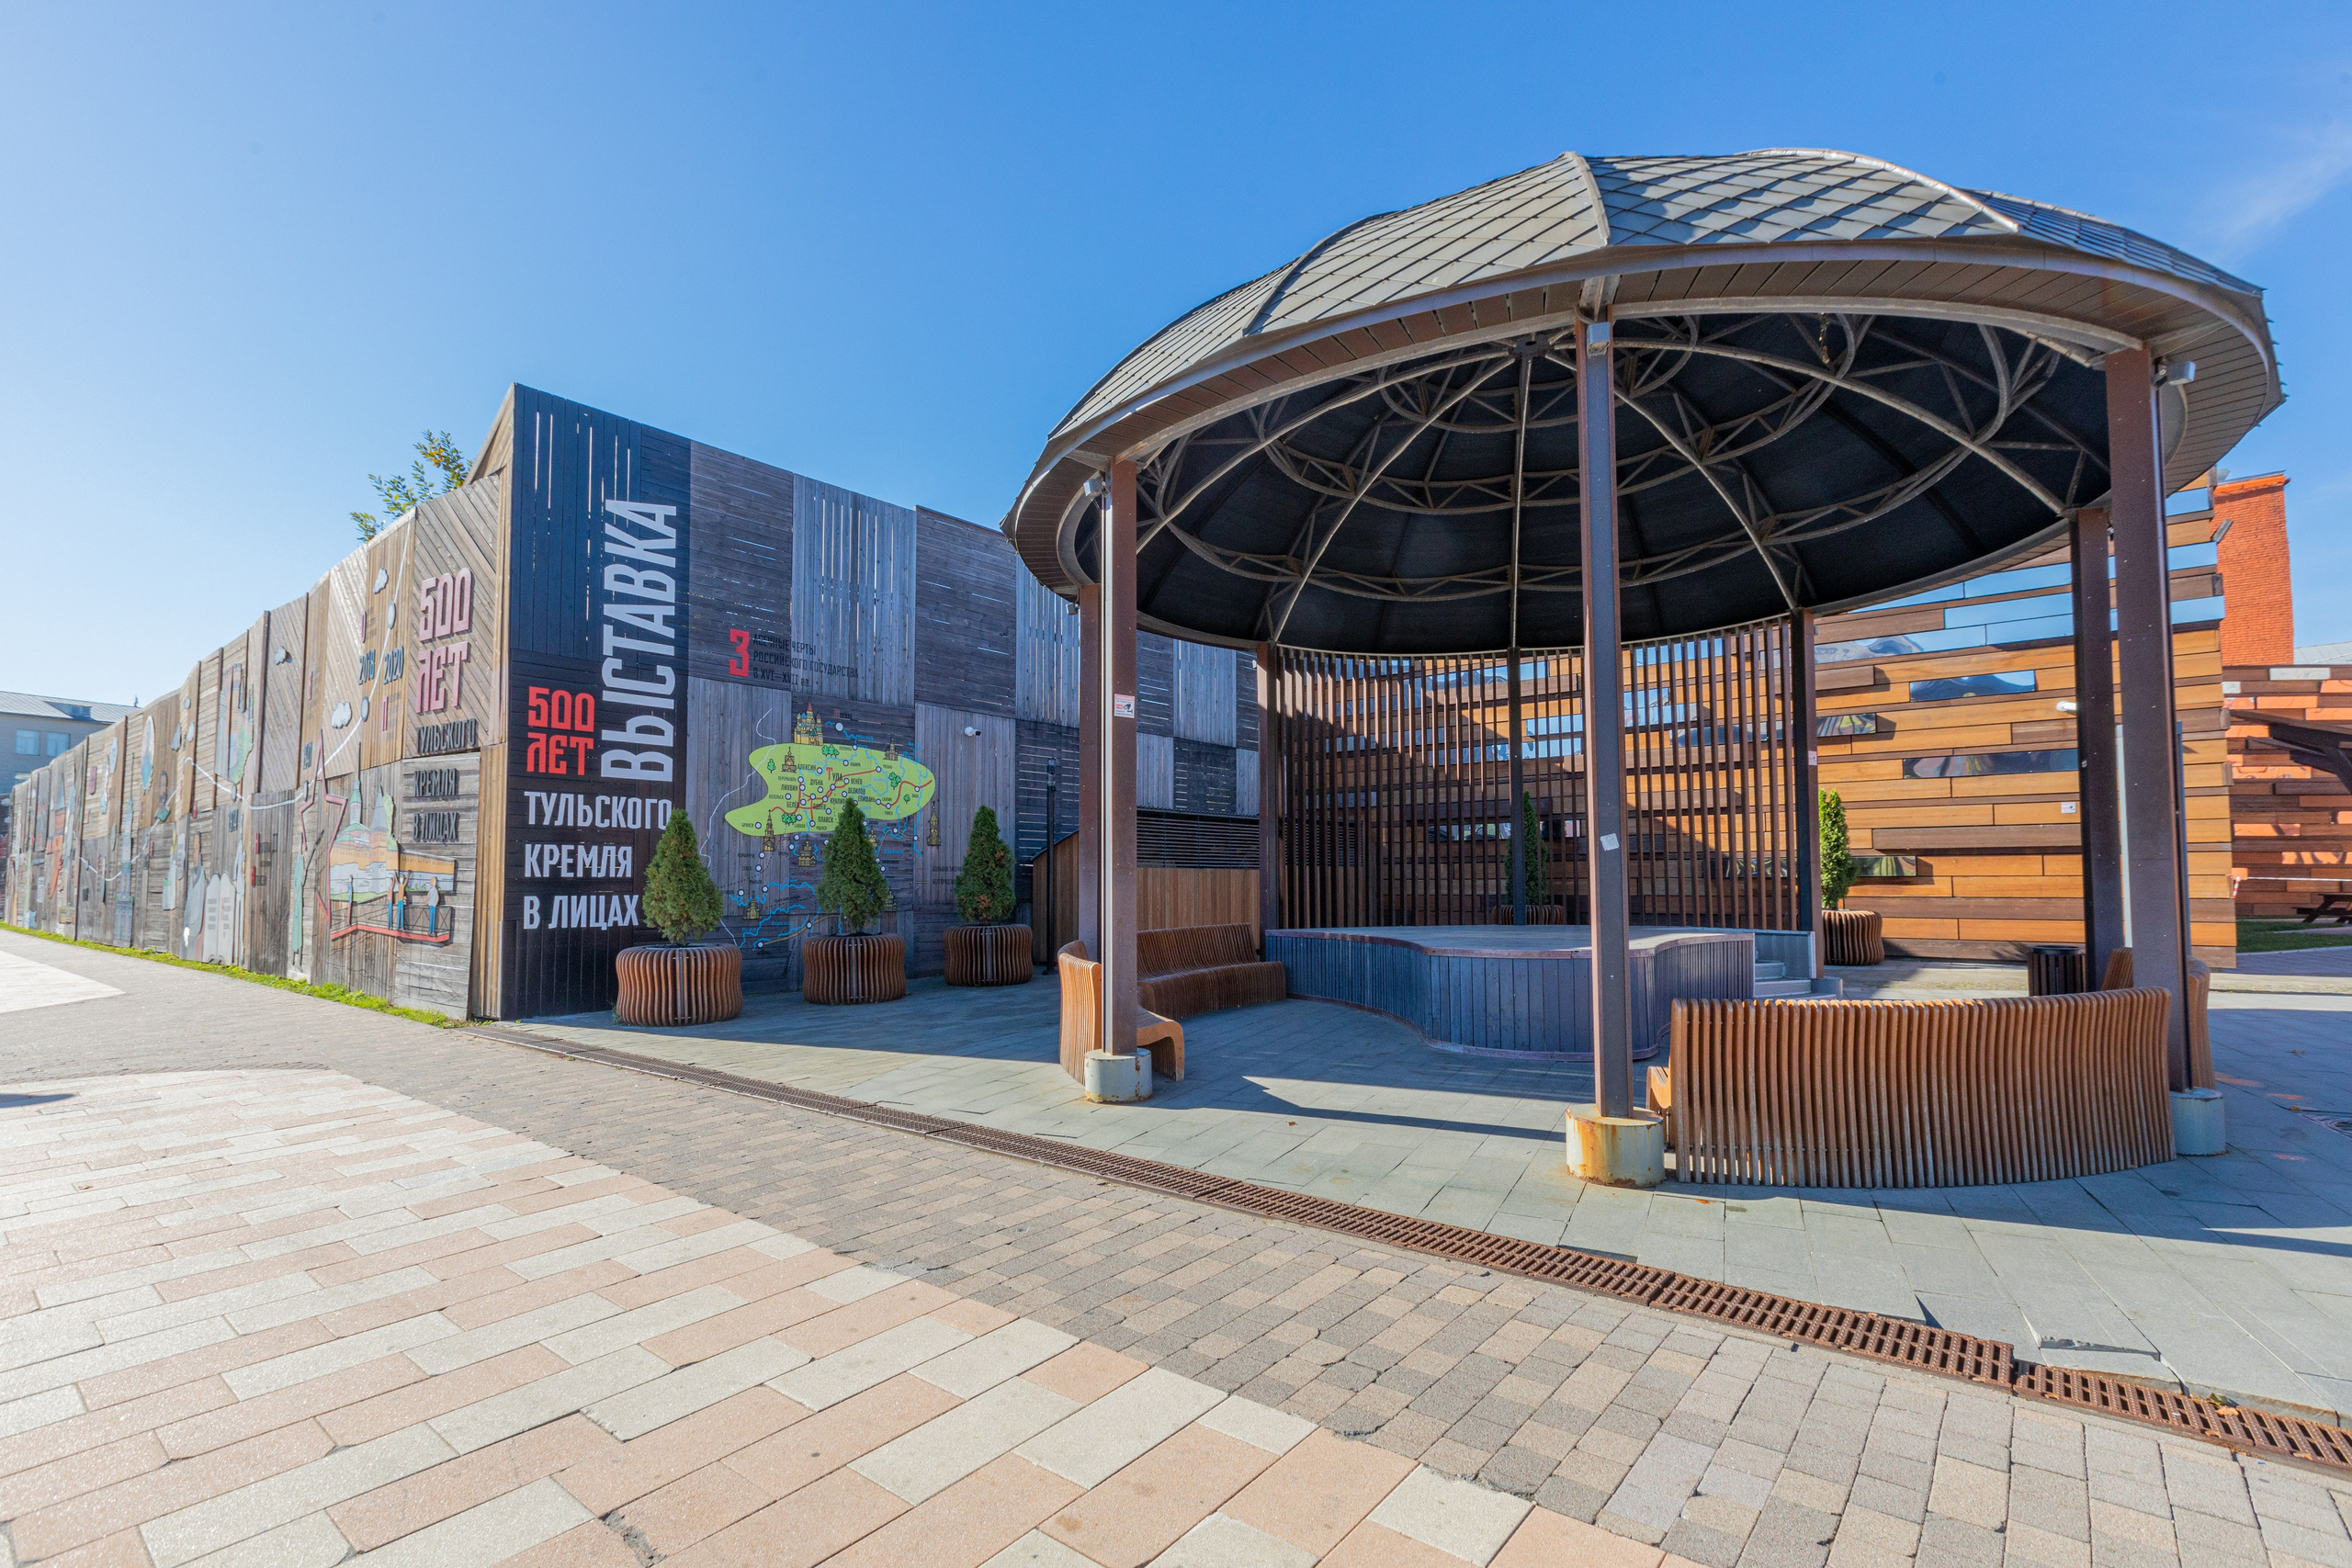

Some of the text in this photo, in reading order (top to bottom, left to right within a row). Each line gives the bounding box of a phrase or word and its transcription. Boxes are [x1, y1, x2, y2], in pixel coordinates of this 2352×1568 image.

[419, 567, 473, 642] 500
[601, 499, 676, 782] ВЫСТАВКА
[791, 641, 816, 656] ЧЕРТЫ
[382, 645, 403, 685] 2020
[415, 641, 469, 714] ЛЕТ
[753, 650, 859, 679] РОССИЙСКОГО ГОСУДАРСТВА
[528, 686, 595, 732] 500
[415, 717, 478, 755] ТУЛЬСКОГО
[526, 732, 594, 775] ЛЕТ
[413, 768, 458, 797] КРЕМЛЯ
[413, 811, 458, 843] В ЛИЦАХ
[524, 791, 673, 830] ТУЛЬСКОГО
[525, 843, 632, 878] КРЕМЛЯ
[524, 895, 639, 931] В ЛИЦАХ
